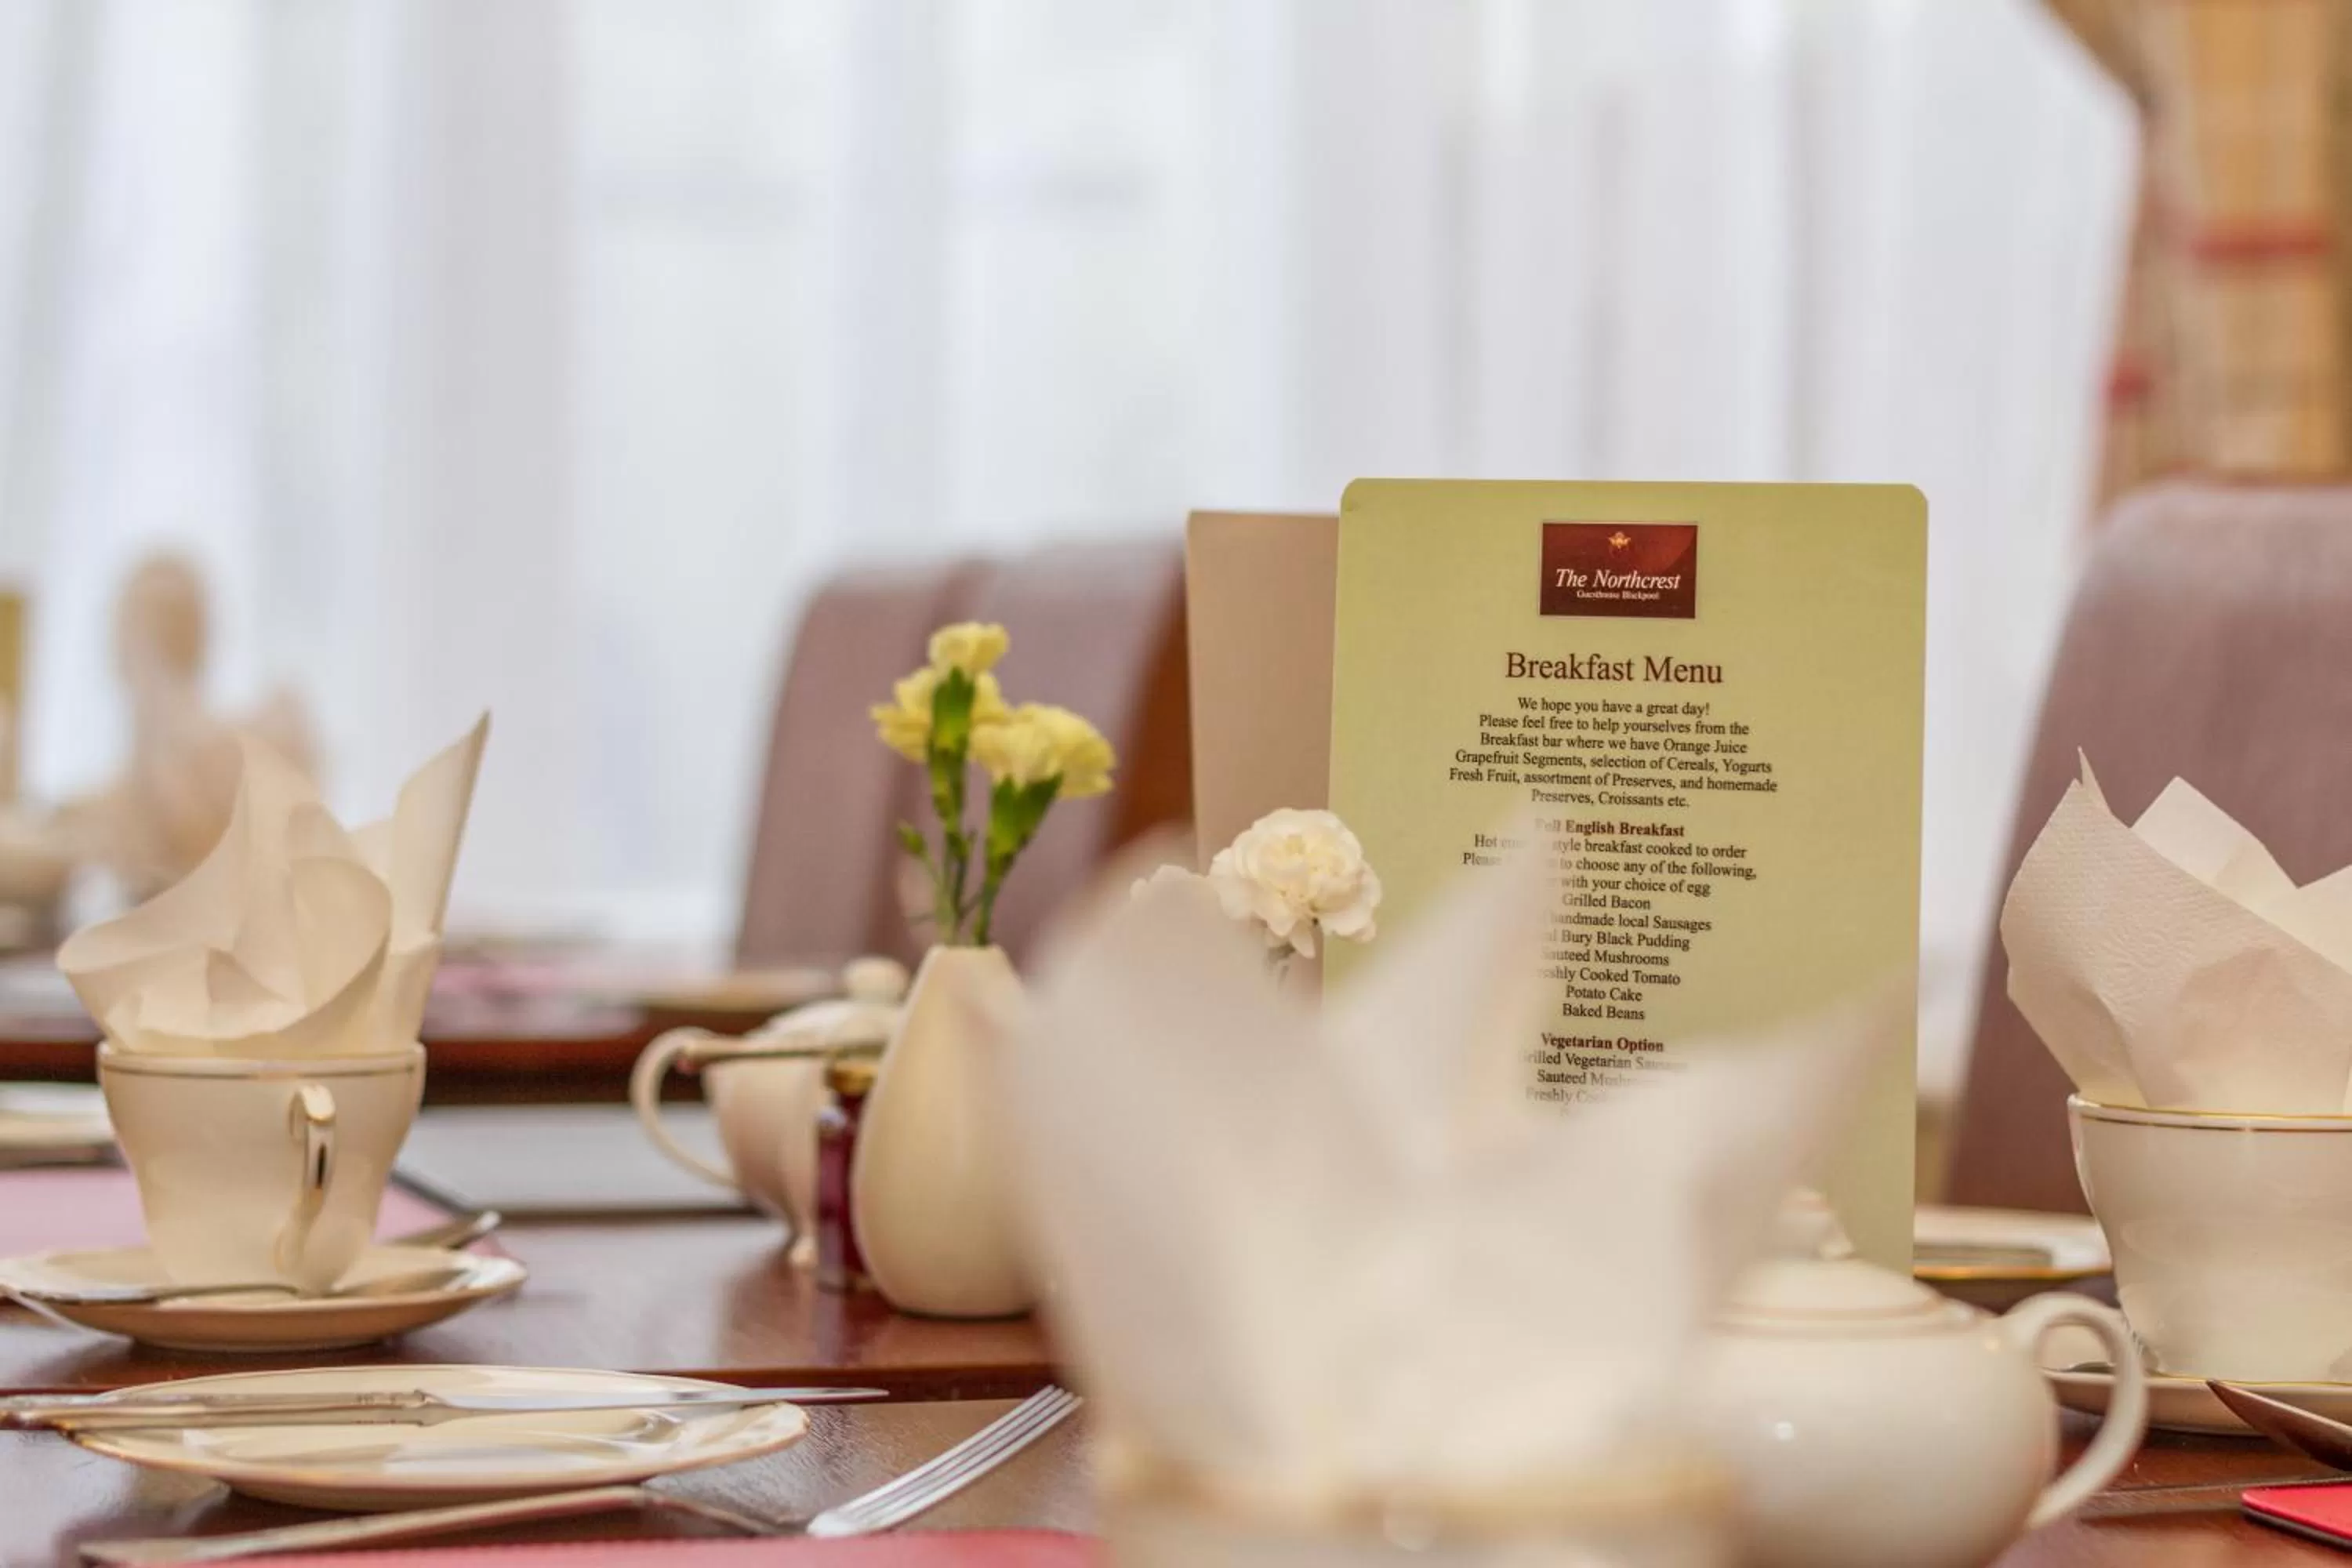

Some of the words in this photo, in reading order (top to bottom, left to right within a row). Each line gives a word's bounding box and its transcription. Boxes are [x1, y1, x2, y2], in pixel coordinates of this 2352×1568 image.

[1555, 568, 1588, 588] The
[1593, 569, 1681, 590] Northcrest
[1622, 591, 1660, 601] Blackpool
[1505, 652, 1635, 681] Breakfast
[1642, 656, 1723, 683] Menu
[1518, 697, 1537, 710] We
[1541, 697, 1572, 714] hope
[1575, 702, 1599, 714] you
[1602, 700, 1631, 714] have
[1635, 705, 1642, 713] a
[1646, 702, 1678, 717] great
[1682, 702, 1710, 718] day!
[1479, 715, 1518, 728] Please
[1523, 716, 1545, 729] feel
[1549, 717, 1573, 730] free
[1577, 718, 1588, 730] to
[1592, 718, 1619, 735] help
[1623, 720, 1690, 735] yourselves
[1694, 722, 1726, 735] from
[1730, 723, 1749, 735] the
[1479, 732, 1539, 747] Breakfast
[1543, 735, 1563, 748] bar
[1566, 736, 1604, 750] where
[1608, 740, 1626, 750] we
[1630, 738, 1659, 751] have
[1663, 739, 1710, 755] Orange
[1713, 741, 1747, 754] Juice
[1455, 750, 1519, 767] Grapefruit
[1523, 752, 1586, 768] Segments,
[1590, 754, 1646, 769] selection
[1650, 756, 1665, 770] of
[1667, 757, 1718, 772] Cereals,
[1724, 759, 1772, 775] Yogurts
[1449, 768, 1483, 782] Fresh
[1487, 769, 1520, 784] Fruit,
[1524, 772, 1591, 786] assortment
[1595, 772, 1610, 786] of
[1612, 774, 1676, 790] Preserves,
[1680, 776, 1703, 789] and
[1707, 777, 1777, 792] homemade
[1531, 789, 1594, 806] Preserves,
[1598, 791, 1664, 807] Croissants
[1668, 794, 1690, 808] etc.
[1566, 820, 1614, 837] English
[1620, 822, 1684, 837] Breakfast
[1475, 833, 1497, 848] Hot
[1584, 840, 1642, 855] breakfast
[1646, 842, 1692, 856] cooked
[1696, 845, 1708, 857] to
[1711, 846, 1748, 859] order
[1560, 859, 1572, 870] to
[1576, 858, 1620, 873] choose
[1624, 862, 1646, 876] any
[1650, 861, 1664, 873] of
[1668, 862, 1687, 875] the
[1690, 862, 1756, 880] following,
[1562, 876, 1588, 889] with
[1592, 879, 1621, 893] your
[1624, 879, 1666, 892] choice
[1669, 879, 1685, 893] of
[1686, 883, 1711, 897] egg
[1562, 894, 1606, 909] Grilled
[1611, 895, 1650, 910] Bacon
[1619, 914, 1649, 927] local
[1653, 916, 1711, 933] Sausages
[1562, 931, 1592, 945] Bury
[1597, 931, 1633, 946] Black
[1637, 933, 1690, 952] Pudding
[1541, 948, 1591, 962] auteed
[1594, 949, 1669, 966] Mushrooms
[1580, 967, 1628, 982] Cooked
[1632, 971, 1680, 985] Tomato
[1566, 985, 1606, 1000] Potato
[1610, 987, 1642, 1001] Cake
[1563, 1004, 1602, 1018] Baked
[1606, 1005, 1645, 1020] Beans
[1541, 1032, 1613, 1050] Vegetarian
[1617, 1037, 1664, 1054] Option
[1518, 1050, 1561, 1065] rilled
[1566, 1053, 1632, 1069] Vegetarian
[1537, 1069, 1586, 1084] Sauteed
